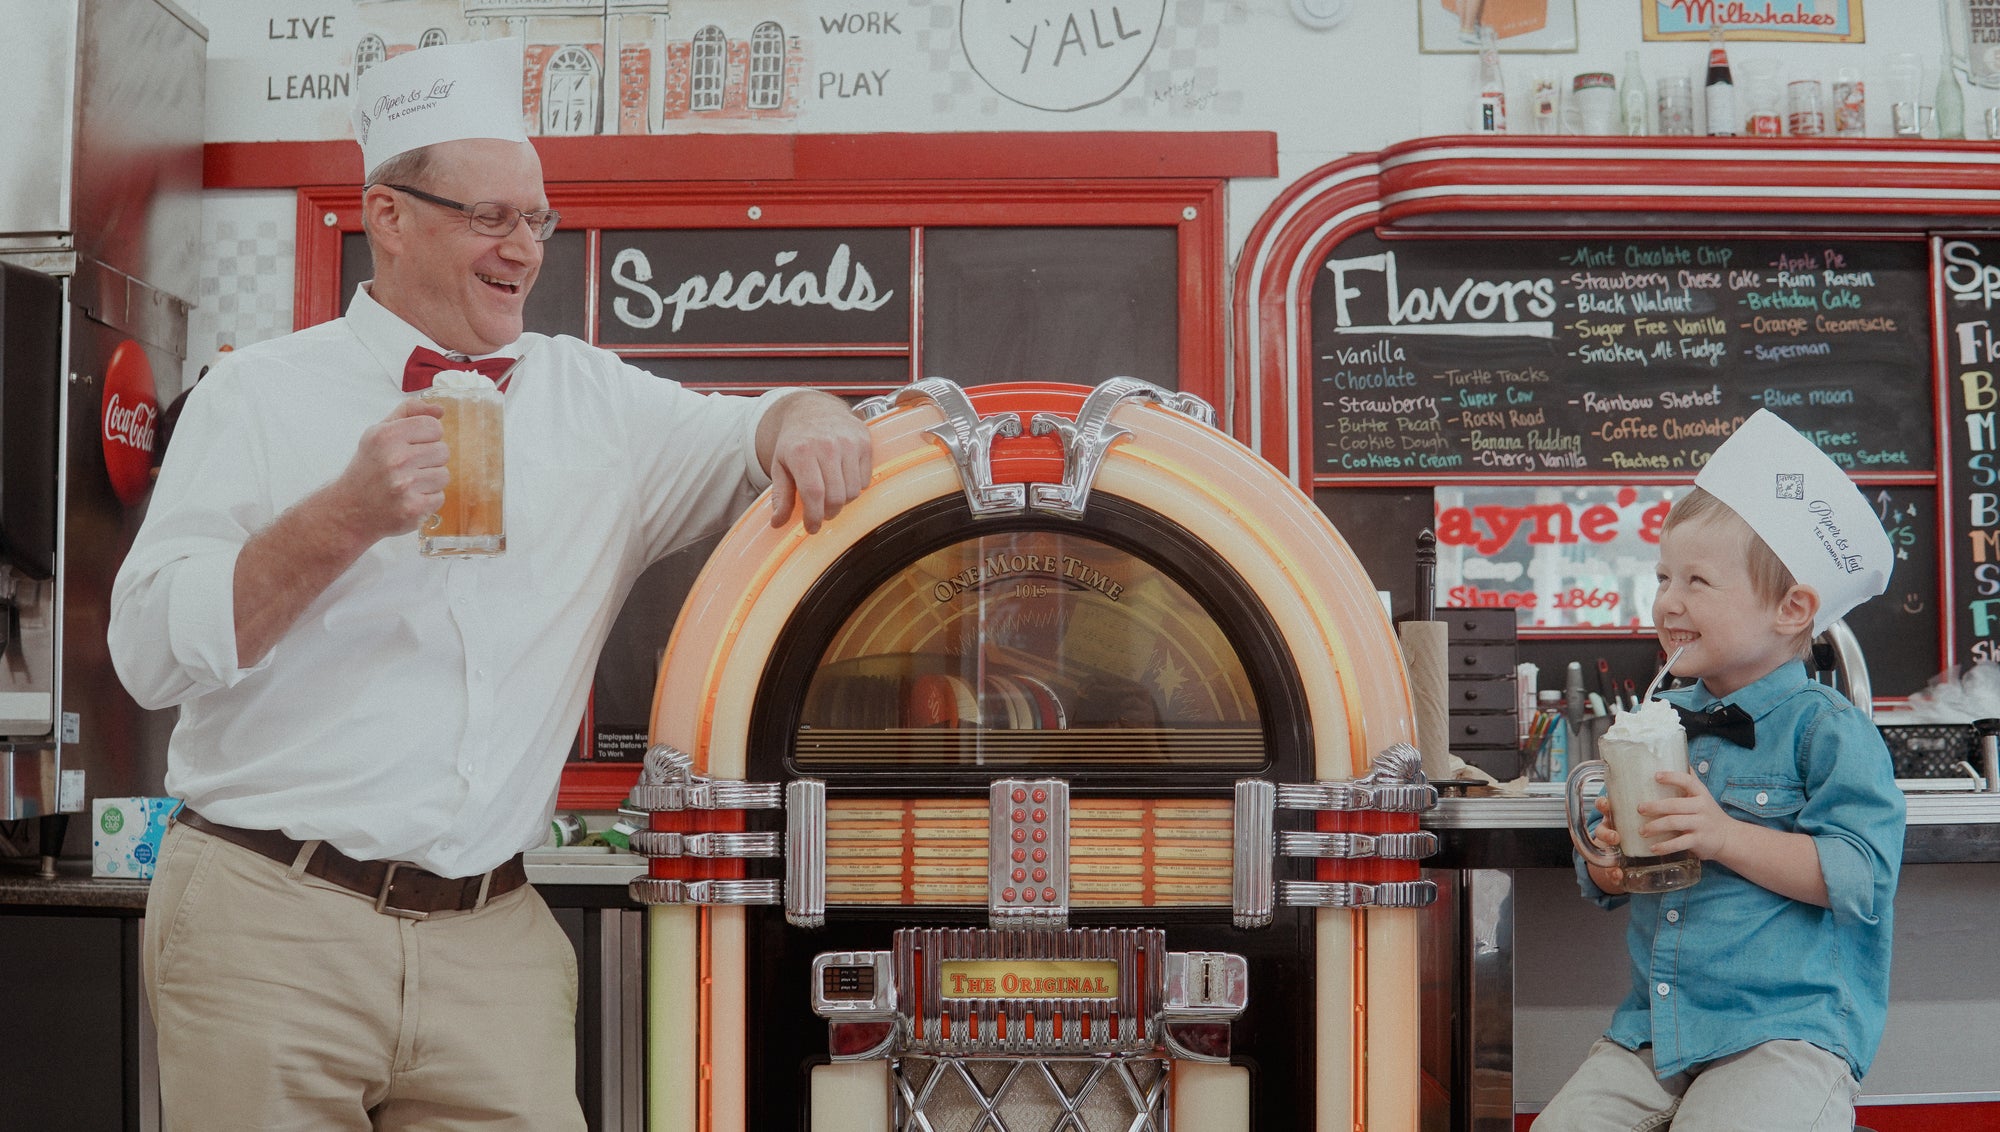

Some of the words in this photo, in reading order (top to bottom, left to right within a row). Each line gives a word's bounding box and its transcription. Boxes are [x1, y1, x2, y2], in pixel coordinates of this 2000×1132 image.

[820, 12, 901, 35] WORK
[1670, 0, 1836, 26] Milkshakes
[269, 16, 335, 40] LIVE
[1972, 29, 2000, 43] FLO
[1010, 6, 1141, 74] Y'ALL
[267, 72, 350, 101] LEARN
[819, 70, 890, 100] PLAY
[373, 95, 405, 120] Piper
[407, 89, 422, 103] &
[423, 78, 456, 101] Leaf
[388, 110, 400, 122] TEA
[402, 101, 438, 117] COMPANY
[1572, 246, 1615, 267] Mint
[1624, 245, 1691, 267] Chocolate
[1697, 247, 1732, 268] Chip
[1778, 253, 1819, 271] Apple
[1825, 249, 1848, 269] Pie
[611, 243, 894, 333] Specials
[1325, 250, 1557, 327] Flavors
[1571, 271, 1670, 291] Strawberry
[1678, 270, 1722, 289] Cheese
[1729, 270, 1761, 289] Cake
[1777, 271, 1816, 288] Rum
[1823, 271, 1876, 288] Raisin
[1578, 293, 1627, 315] Black
[1631, 288, 1693, 313] Walnut
[1747, 291, 1818, 312] Birthday
[1822, 290, 1862, 310] Cake
[1574, 319, 1625, 347] Sugar
[1635, 318, 1668, 335] Free
[1673, 316, 1728, 336] Vanilla
[1753, 316, 1809, 336] Orange
[1816, 316, 1897, 334] Creamsicle
[1336, 340, 1406, 366] Vanilla
[1578, 346, 1648, 368] Smokey
[1680, 337, 1728, 368] Fudge
[1755, 340, 1832, 362] Superman
[1334, 367, 1417, 391] Chocolate
[1446, 369, 1492, 386] Turtle
[1499, 366, 1550, 384] Tracks
[1339, 395, 1440, 421] Strawberry
[1459, 388, 1499, 408] Super
[1506, 386, 1535, 404] Cow
[1583, 391, 1654, 412] Rainbow
[1659, 384, 1722, 409] Sherbet
[1763, 387, 1801, 408] Blue
[105, 393, 157, 452] Coca-Cola
[1338, 416, 1389, 434] Butter
[1396, 416, 1442, 432] Pecan
[1462, 410, 1506, 429] Rocky
[1510, 407, 1545, 427] Road
[1601, 417, 1658, 442] Coffee
[1662, 416, 1731, 440] Chocolate
[1340, 435, 1395, 451] Cookie
[1402, 432, 1449, 455] Dough
[1470, 430, 1524, 450] Banana
[1527, 428, 1582, 453] Pudding
[1342, 452, 1401, 469] Cookies
[1418, 452, 1463, 469] Cream
[1481, 451, 1536, 471] Cherry
[1539, 450, 1588, 469] Vanilla
[1612, 450, 1670, 470] Peaches
[1827, 451, 1856, 469] rry
[1856, 449, 1910, 466] Sorbet
[1434, 487, 1672, 556] ayne's
[1808, 499, 1841, 539] Piper
[1813, 526, 1825, 541] TEA
[1823, 540, 1844, 571] COMPANY
[1835, 539, 1849, 552] &
[1841, 554, 1865, 575] Leaf
[933, 565, 981, 603] ONE
[985, 553, 1057, 578] MORE
[1062, 555, 1124, 602] TIME
[1014, 583, 1048, 599] 1015
[1447, 586, 1538, 609] Since
[1553, 588, 1620, 611] 1869
[598, 733, 634, 741] Employees
[104, 812, 121, 821] food
[104, 820, 120, 829] club
[951, 973, 996, 994] THE
[1001, 972, 1109, 994] ORIGINAL
